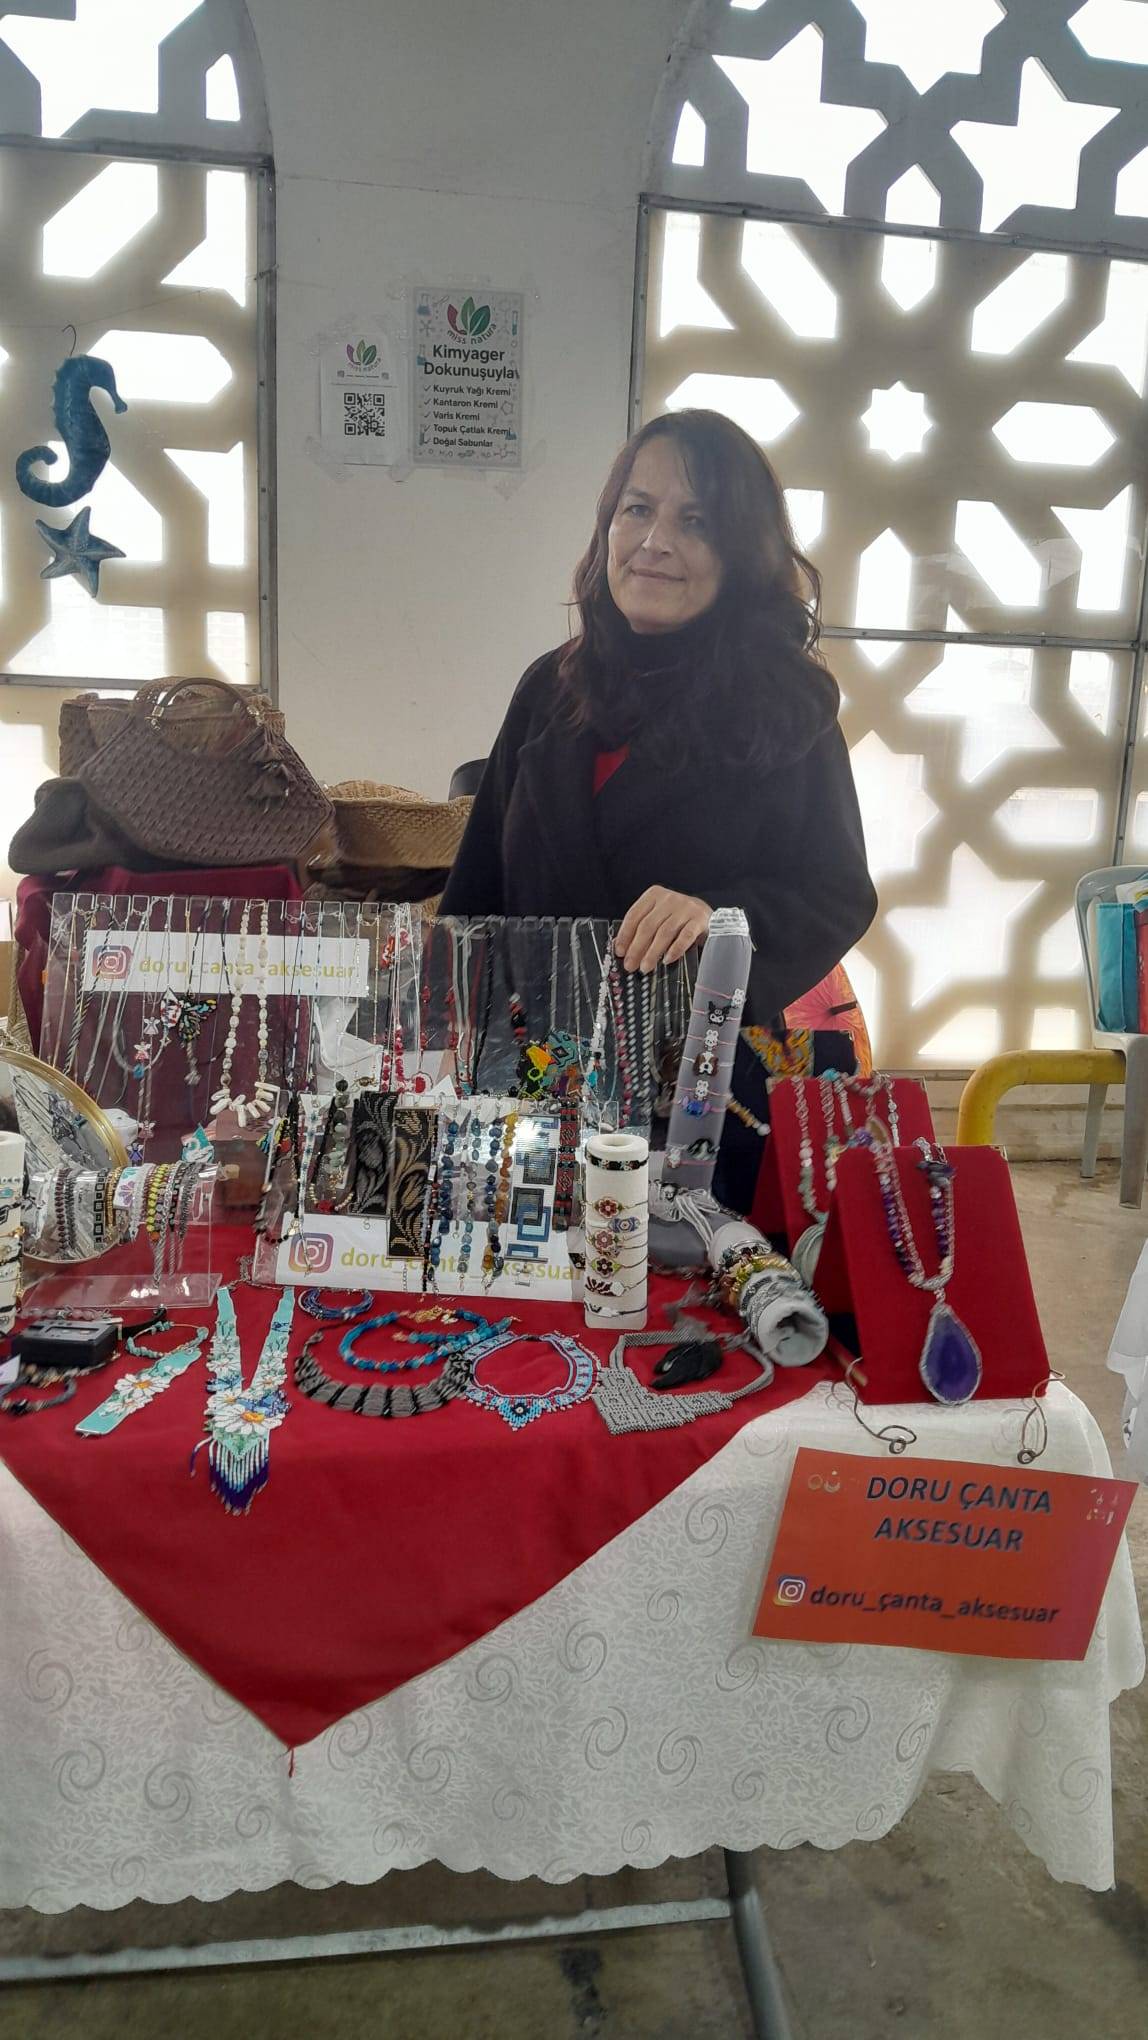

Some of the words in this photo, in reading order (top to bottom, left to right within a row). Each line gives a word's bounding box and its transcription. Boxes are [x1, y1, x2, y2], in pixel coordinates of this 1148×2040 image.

[447, 329, 467, 345] miss
[470, 323, 497, 345] natura
[432, 344, 505, 363] Kimyager
[424, 362, 515, 381] Dokunuşuyla
[433, 384, 465, 395] Kuyruk
[466, 385, 484, 396] Yağı
[486, 387, 511, 397] Kremi
[433, 398, 472, 407] Kantaron
[473, 399, 498, 409] Kremi
[433, 411, 454, 420] Varis
[455, 412, 480, 421] Kremi
[433, 424, 458, 433] Topuk
[459, 425, 485, 435] Çatlak
[487, 426, 511, 436] Kremi
[433, 437, 457, 447] Doğal
[458, 438, 493, 448] Sabunlar
[866, 1476, 951, 1502] DORU
[960, 1481, 1052, 1515] ÇANTA
[873, 1517, 1024, 1552] AKSESUAR
[809, 1585, 1060, 1624] doru_çanta_aksesuar
